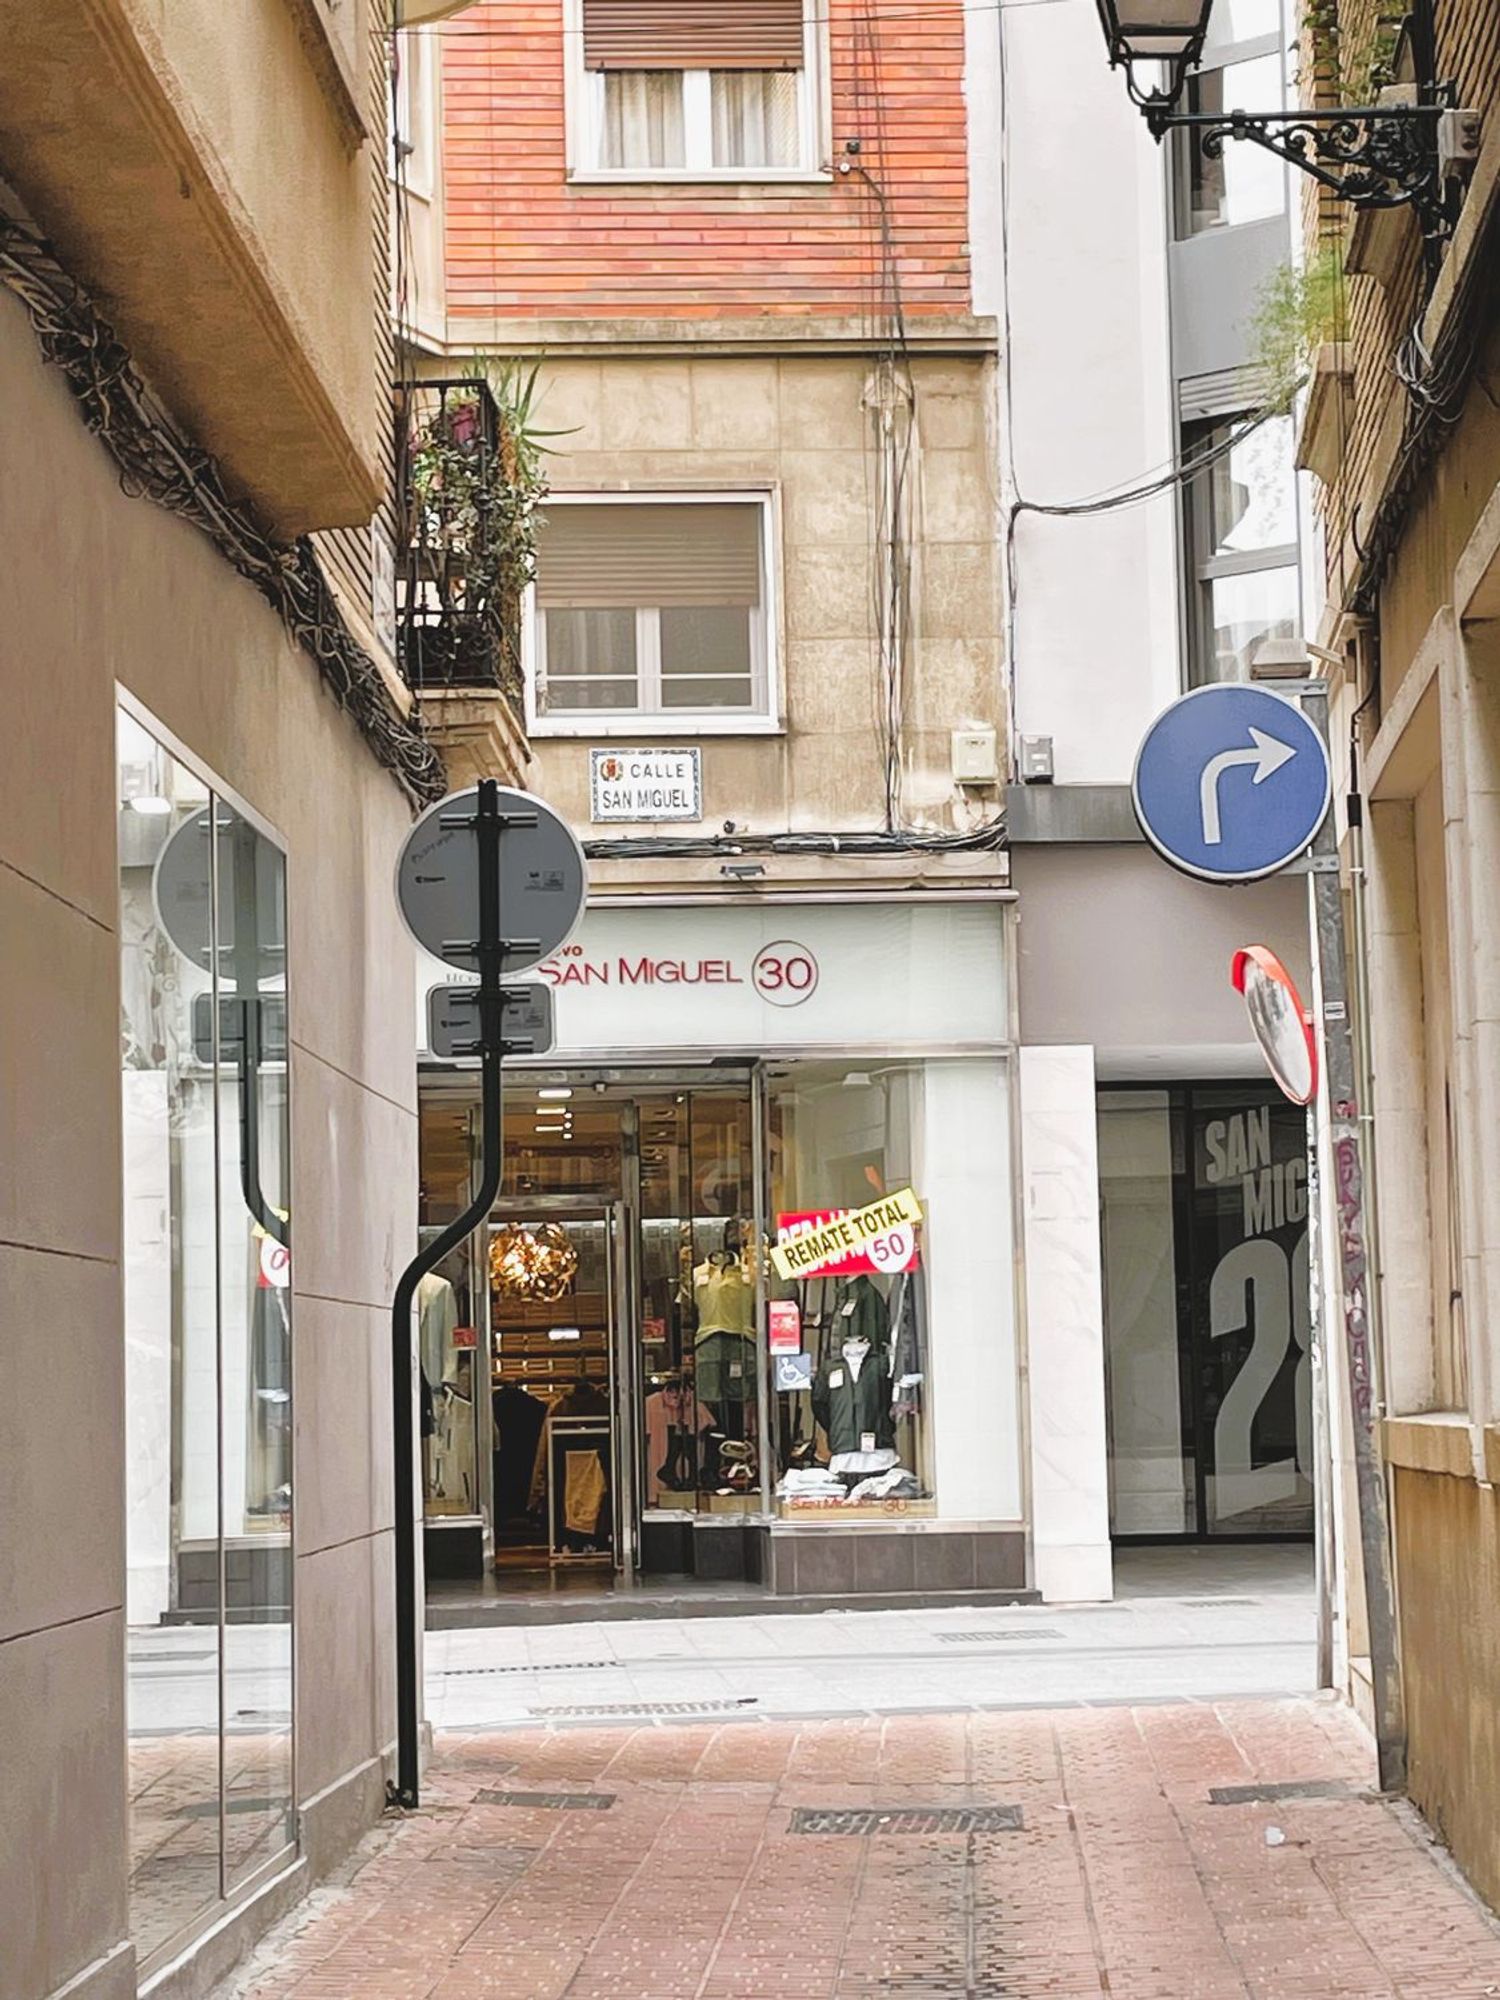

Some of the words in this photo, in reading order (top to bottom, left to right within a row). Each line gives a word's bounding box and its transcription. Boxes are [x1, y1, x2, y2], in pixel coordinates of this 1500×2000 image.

[630, 763, 685, 778] CALLE
[602, 789, 633, 809] SAN
[637, 788, 689, 808] MIGUEL
[538, 959, 609, 985] SAN
[618, 957, 744, 985] MIGUEL
[758, 957, 813, 990] 30
[1205, 1105, 1271, 1183] SAN
[1242, 1157, 1308, 1238] MIG
[783, 1222, 854, 1270] REMATE
[851, 1199, 909, 1238] TOTAL
[873, 1232, 905, 1263] 50
